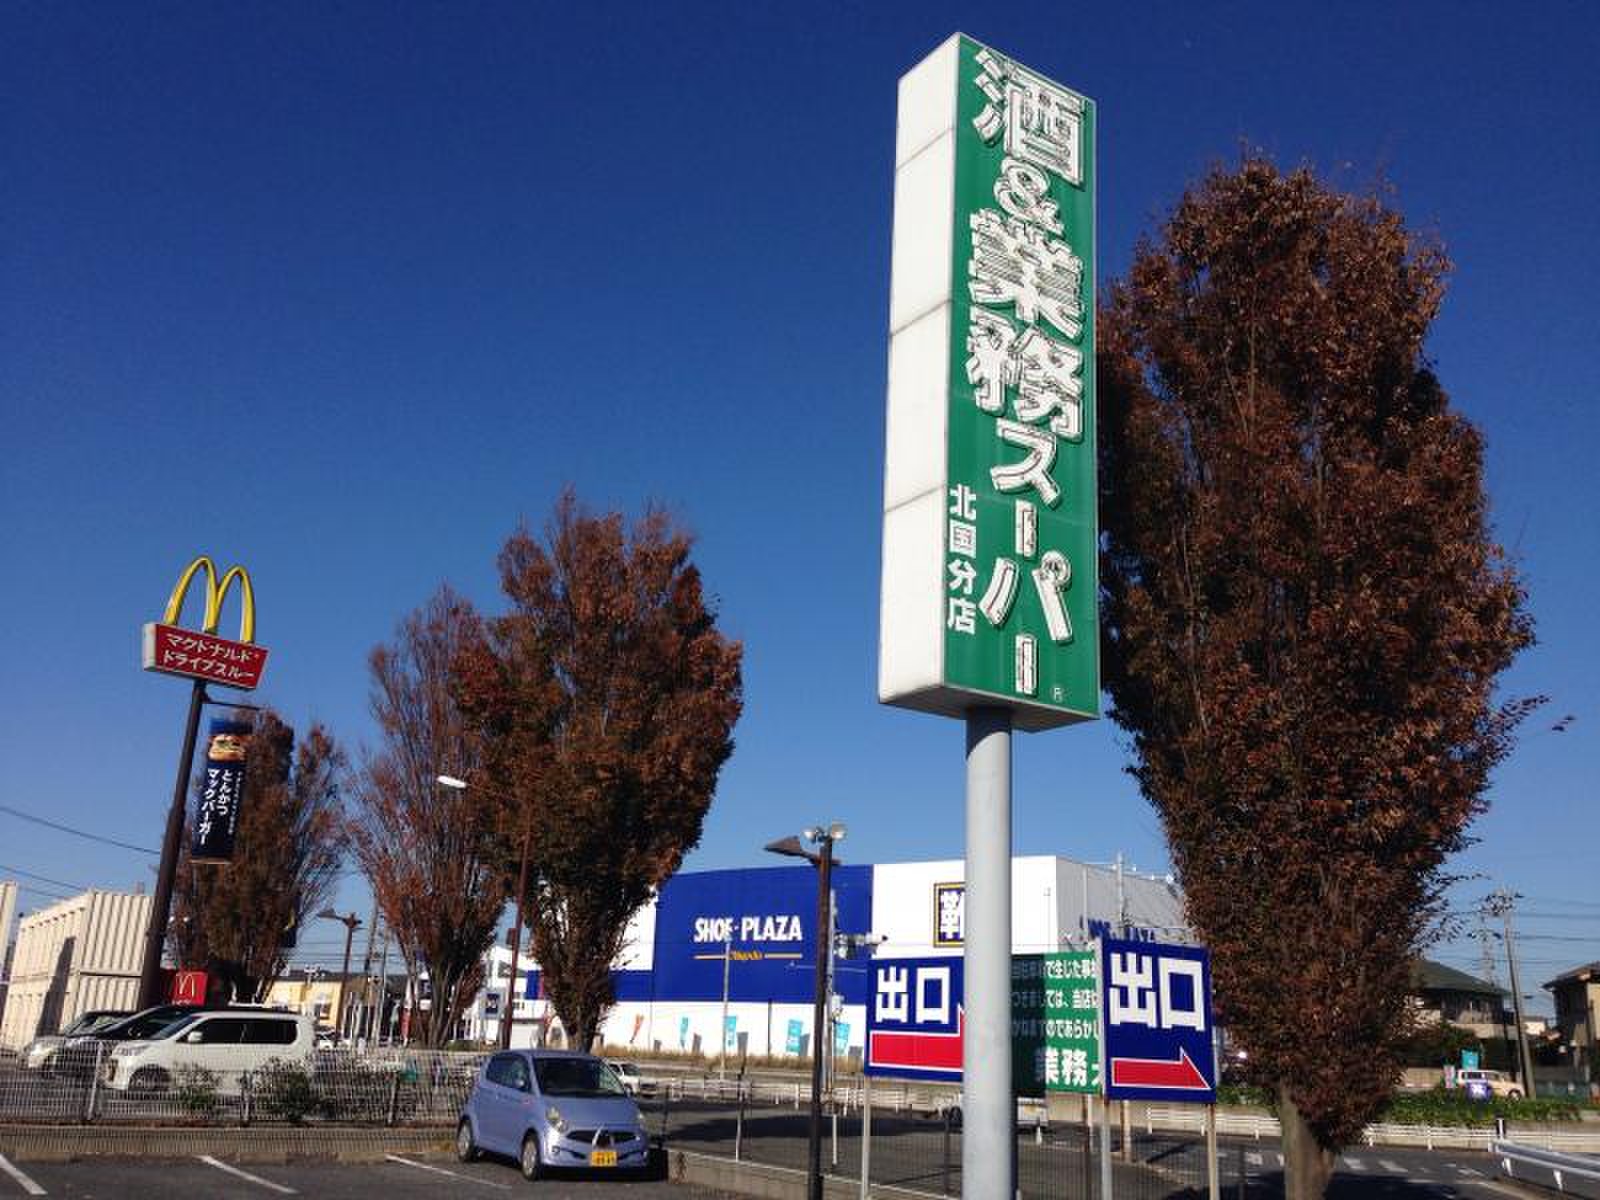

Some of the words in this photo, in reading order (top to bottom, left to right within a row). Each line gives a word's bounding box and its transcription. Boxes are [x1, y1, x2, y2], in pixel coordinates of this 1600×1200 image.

[948, 483, 977, 635] 北国分店
[163, 649, 255, 678] ドライブスルー
[165, 632, 254, 663] マクドナルド
[199, 768, 220, 845] マックバーガー
[216, 768, 233, 816] とんかつ
[875, 964, 951, 1025] 出口
[1109, 952, 1206, 1031] 出口
